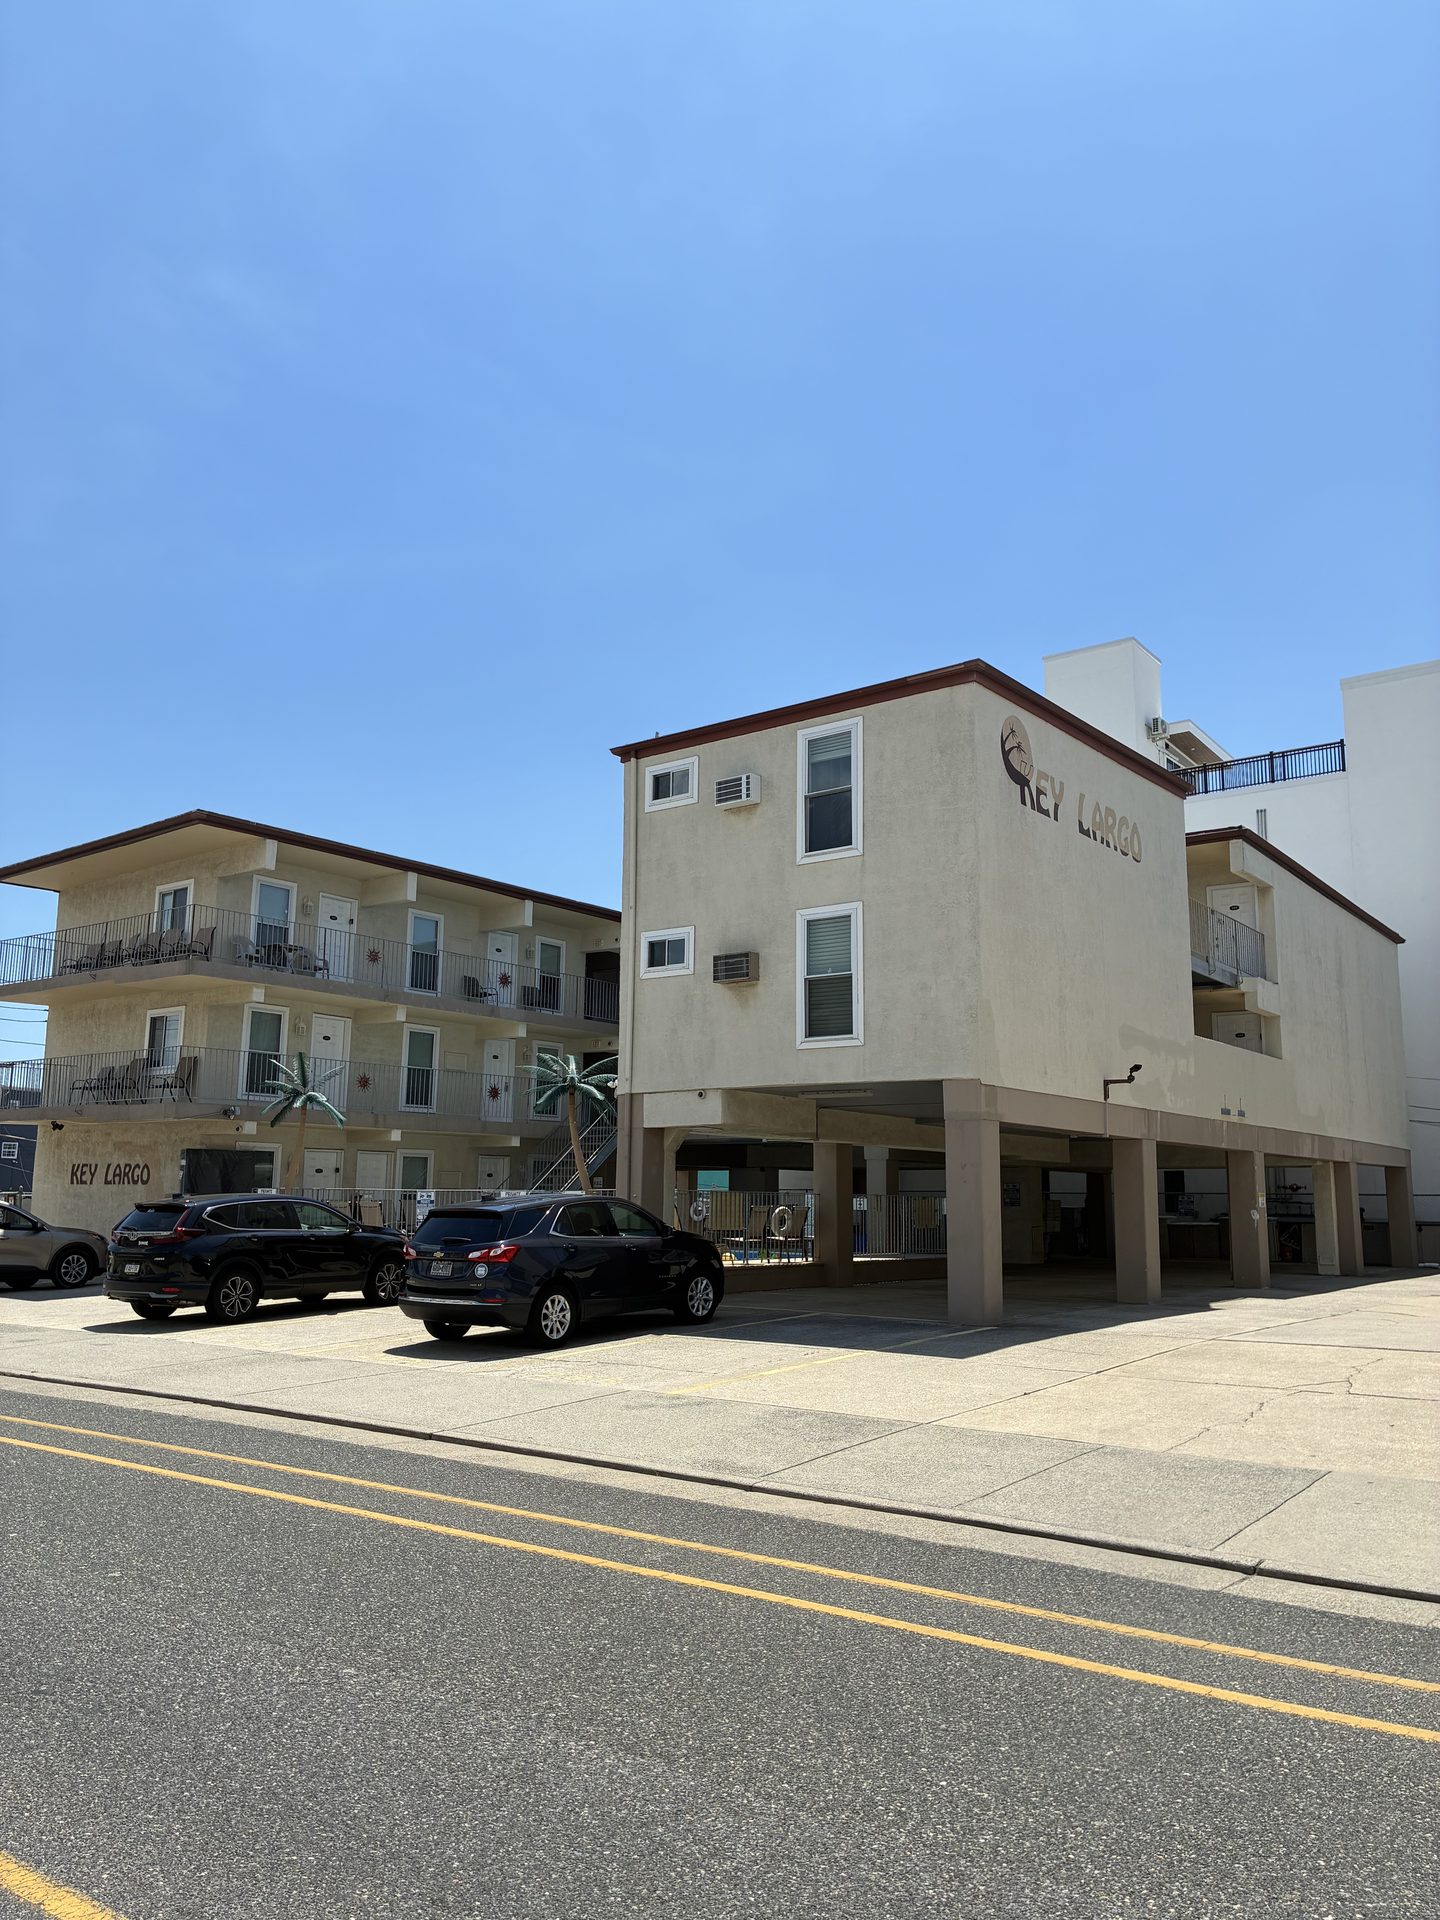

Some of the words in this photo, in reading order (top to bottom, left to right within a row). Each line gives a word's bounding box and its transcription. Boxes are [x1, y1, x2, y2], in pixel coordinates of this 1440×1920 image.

[1019, 760, 1065, 823] KEY
[1078, 793, 1143, 863] LARGO
[70, 1163, 98, 1185] KEY
[104, 1163, 151, 1185] LARGO
